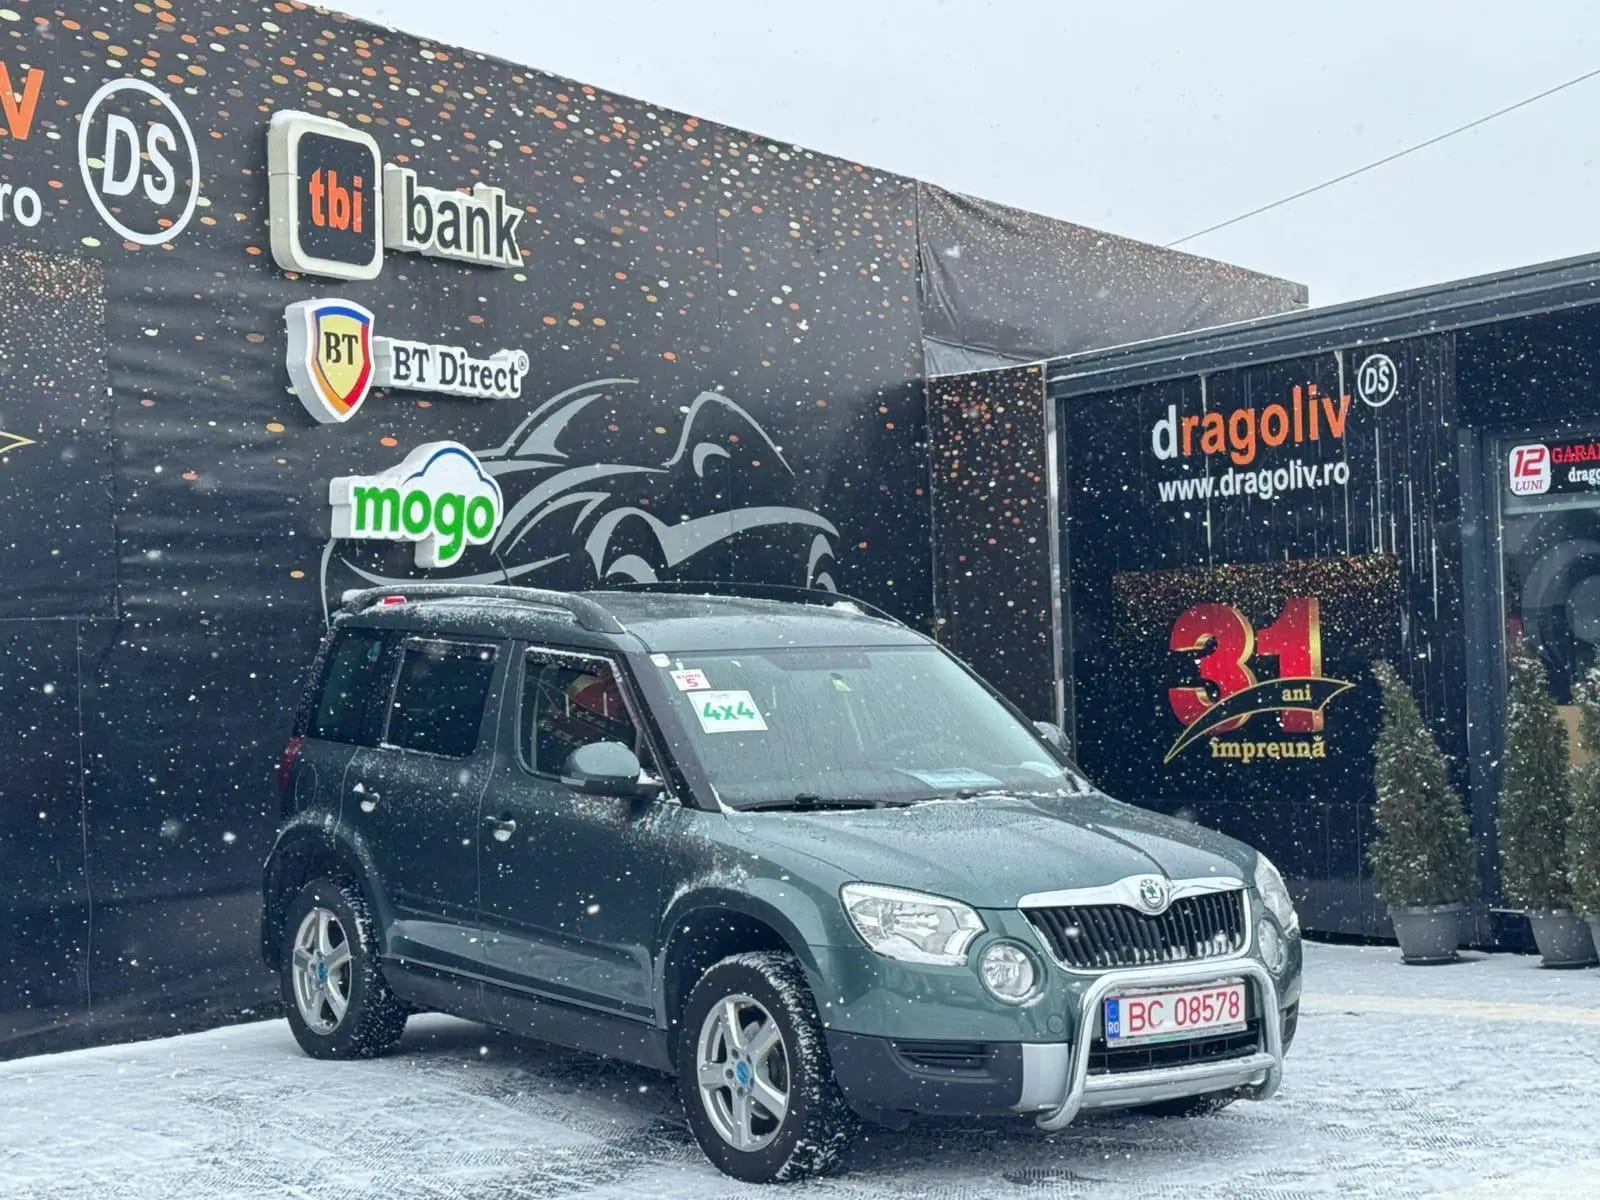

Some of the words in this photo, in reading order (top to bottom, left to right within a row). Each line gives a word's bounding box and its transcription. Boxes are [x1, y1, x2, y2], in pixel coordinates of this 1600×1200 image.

[102, 114, 177, 205] DS
[309, 168, 362, 233] tbi
[406, 176, 520, 260] bank
[324, 332, 358, 365] BT
[393, 346, 430, 383] BT
[1364, 364, 1390, 395] DS
[1152, 384, 1351, 465] dragoliv
[1513, 448, 1545, 477] 12
[1158, 459, 1350, 502] www.dragoliv.ro
[1514, 480, 1543, 492] LUNI
[354, 487, 494, 560] mogo
[686, 679, 699, 688] 5
[1168, 598, 1324, 736] 31
[1281, 684, 1312, 701] ani
[1209, 735, 1326, 763] împreună
[1108, 1021, 1119, 1034] RO
[1129, 1000, 1164, 1032] BC
[1174, 991, 1239, 1026] 08578
